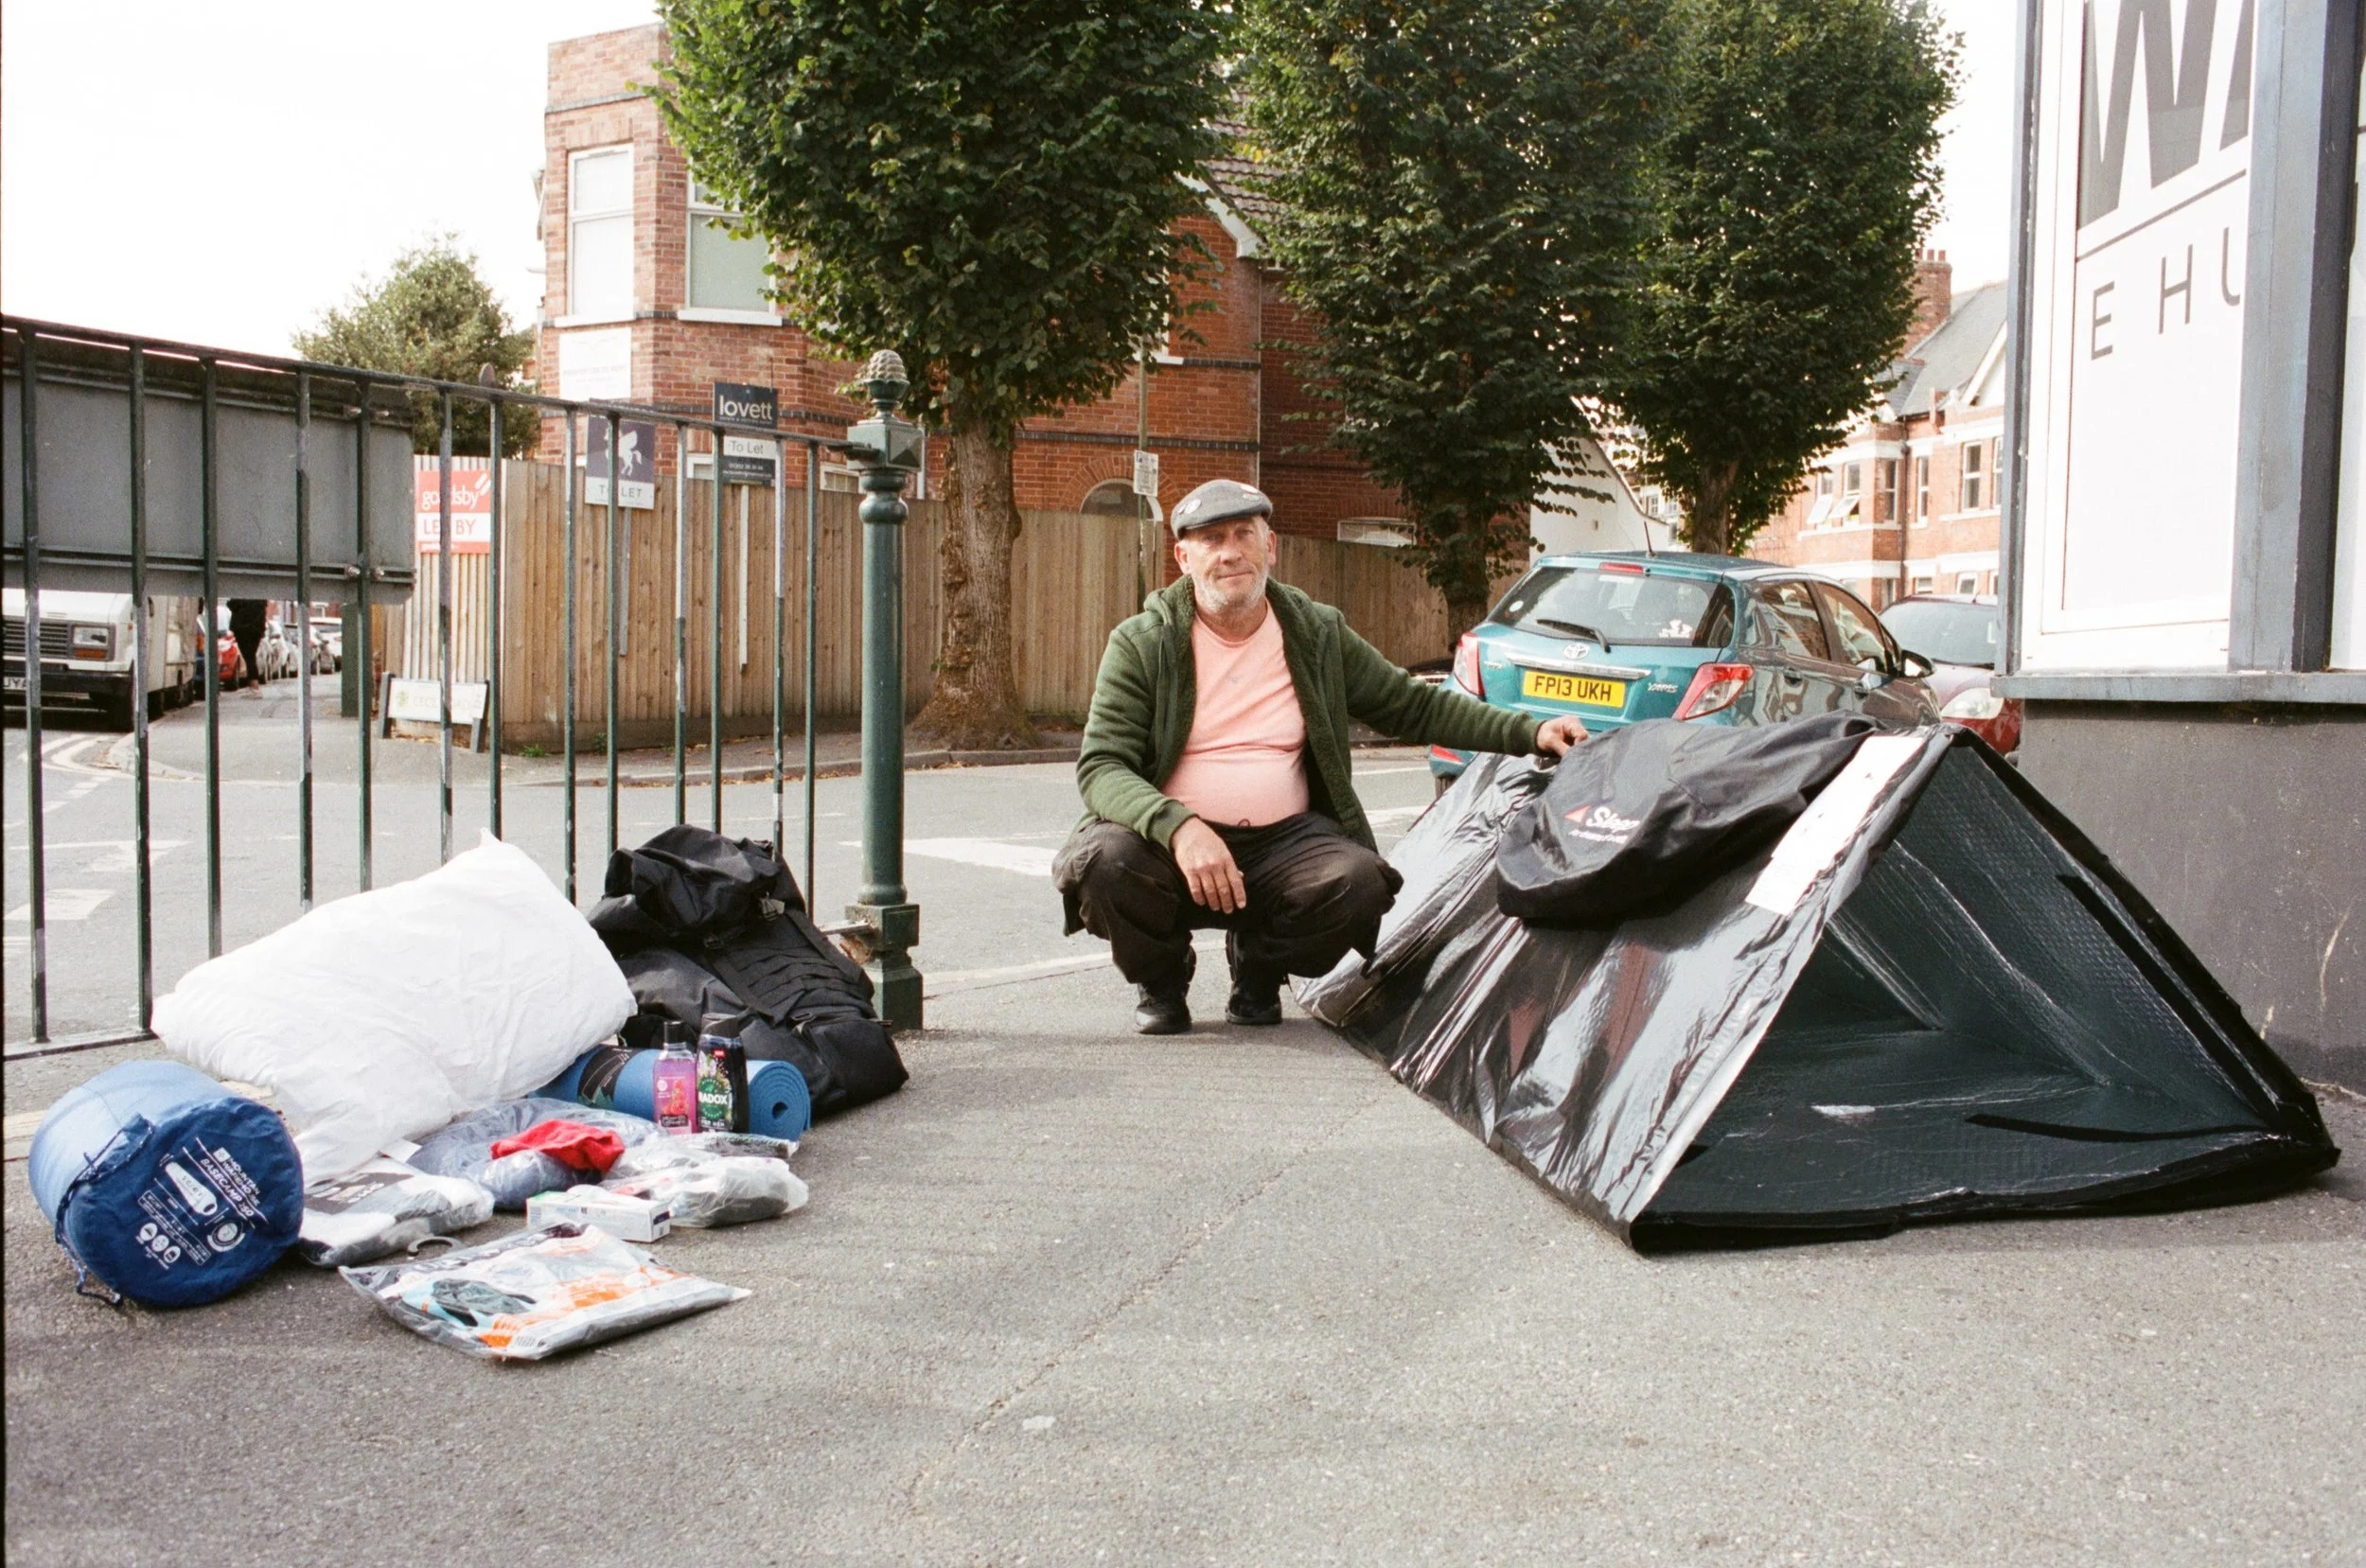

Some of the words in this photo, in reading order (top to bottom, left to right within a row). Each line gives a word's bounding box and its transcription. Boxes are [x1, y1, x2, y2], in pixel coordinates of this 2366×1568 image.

[2077, 0, 2253, 230] W
[719, 395, 773, 420] lovett
[729, 440, 744, 452] To
[747, 441, 764, 455] Let
[421, 484, 480, 511] gosby
[621, 486, 643, 498] LET
[455, 519, 477, 537] BY
[1534, 675, 1572, 699] FP13
[1577, 679, 1613, 702] UKH
[200, 1158, 243, 1203] BASECAMP
[223, 1161, 261, 1207] WAREHOSE
